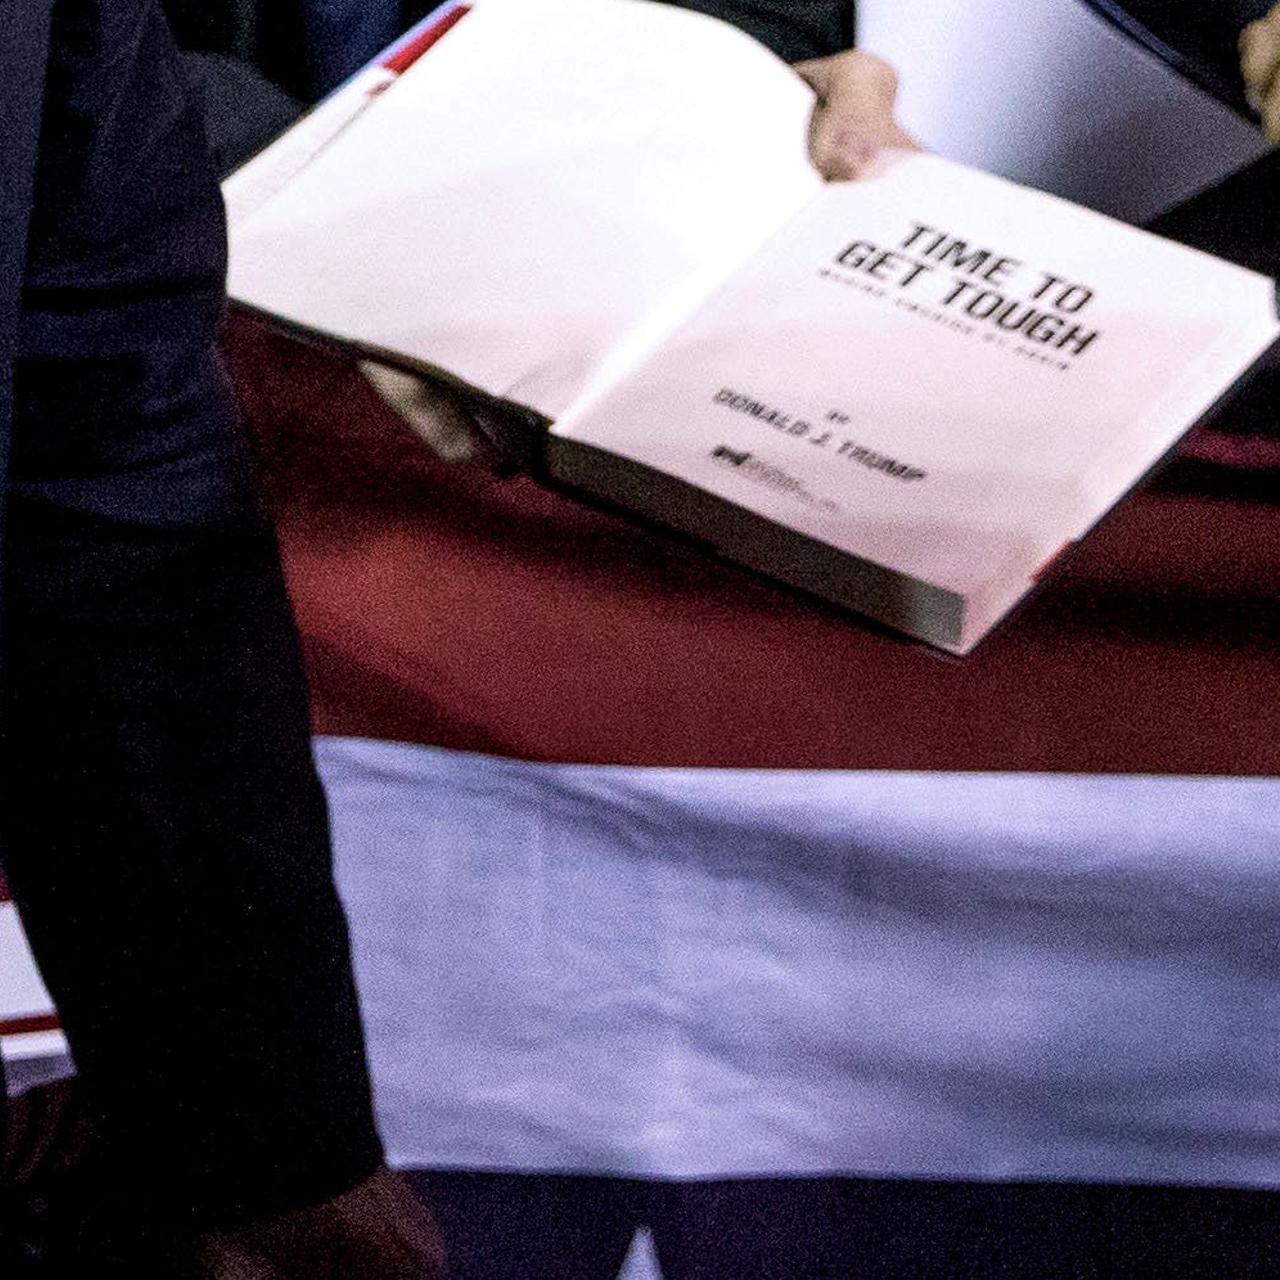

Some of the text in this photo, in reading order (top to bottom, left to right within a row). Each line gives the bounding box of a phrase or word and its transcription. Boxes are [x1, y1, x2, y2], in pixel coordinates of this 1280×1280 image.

[834, 240, 935, 287] GET
[942, 280, 1102, 356] TOUGH
[901, 220, 1096, 314] TIME TO
[712, 388, 811, 438] DONALD
[837, 440, 929, 482] TRUMP
